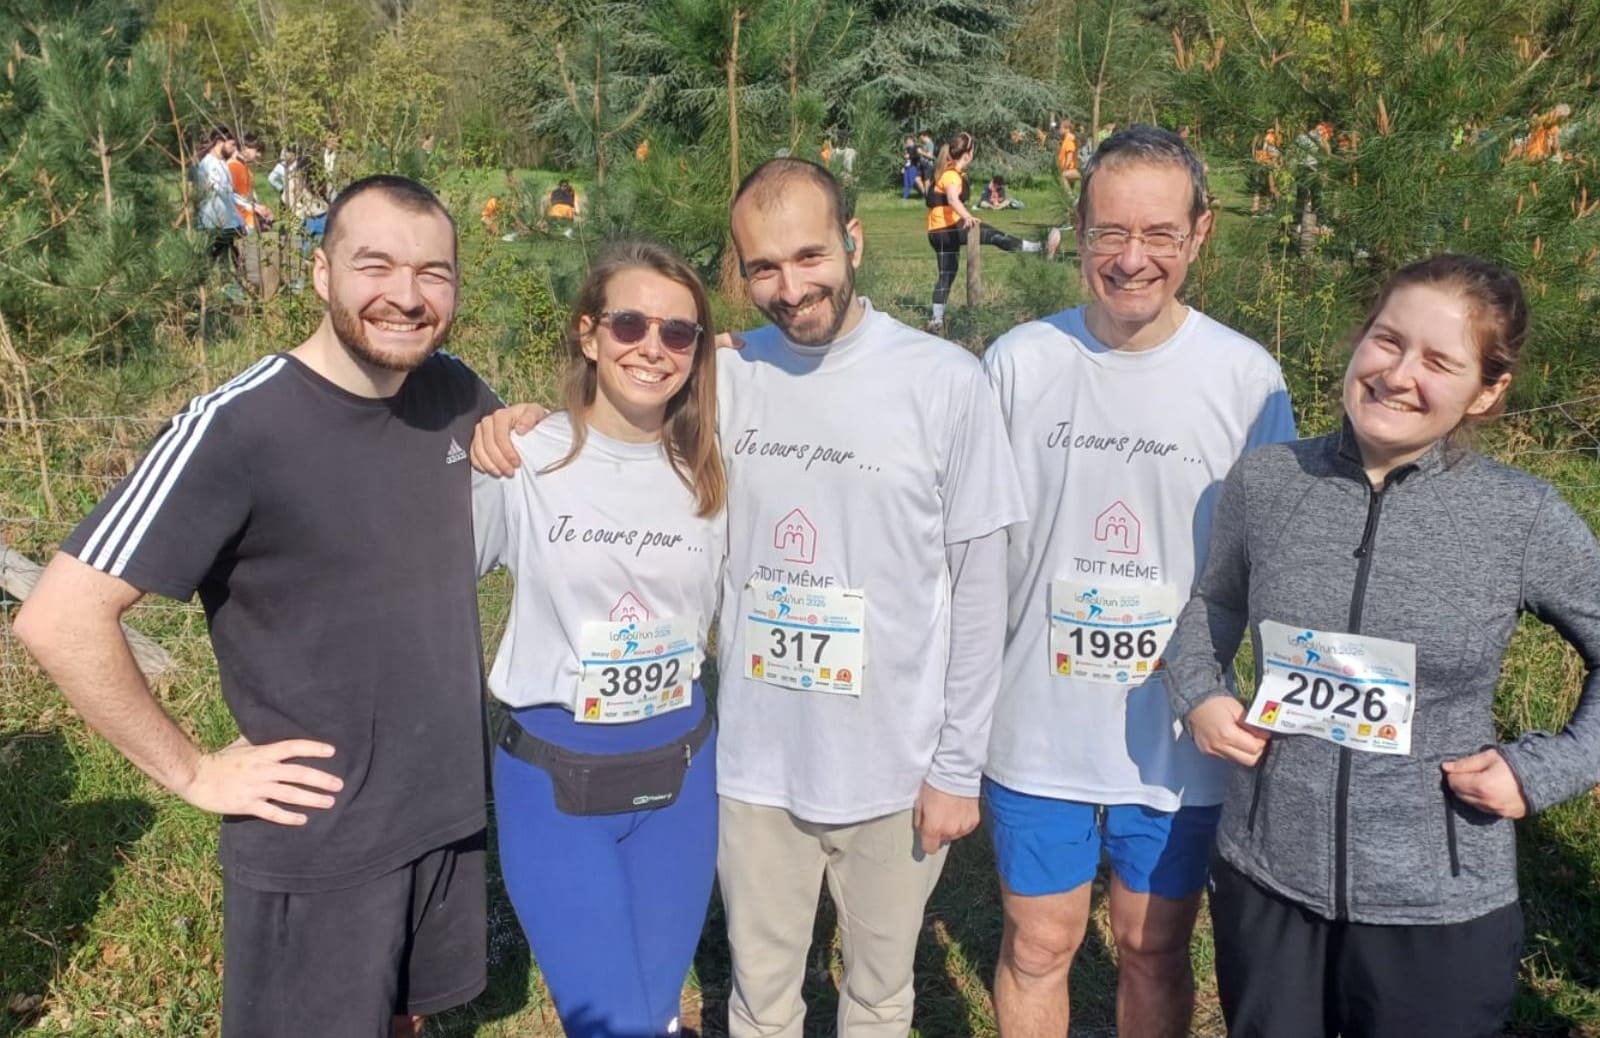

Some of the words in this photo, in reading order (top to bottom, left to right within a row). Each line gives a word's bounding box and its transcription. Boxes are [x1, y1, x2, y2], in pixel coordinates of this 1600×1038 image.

[735, 429, 758, 455] Je
[760, 442, 810, 459] cours
[805, 445, 855, 471] pour
[1047, 421, 1071, 448] Je
[1074, 434, 1129, 451] cours
[1126, 437, 1178, 464] pour
[548, 515, 576, 543] Je
[582, 528, 638, 545] cours
[635, 530, 683, 557] pour
[759, 565, 784, 581] TOIT
[1073, 557, 1106, 574] TOIT
[1111, 561, 1159, 580] MÊME
[770, 628, 831, 664] 317
[1070, 627, 1157, 660] 1986
[600, 658, 680, 697] 3892
[1282, 672, 1387, 722] 2026
